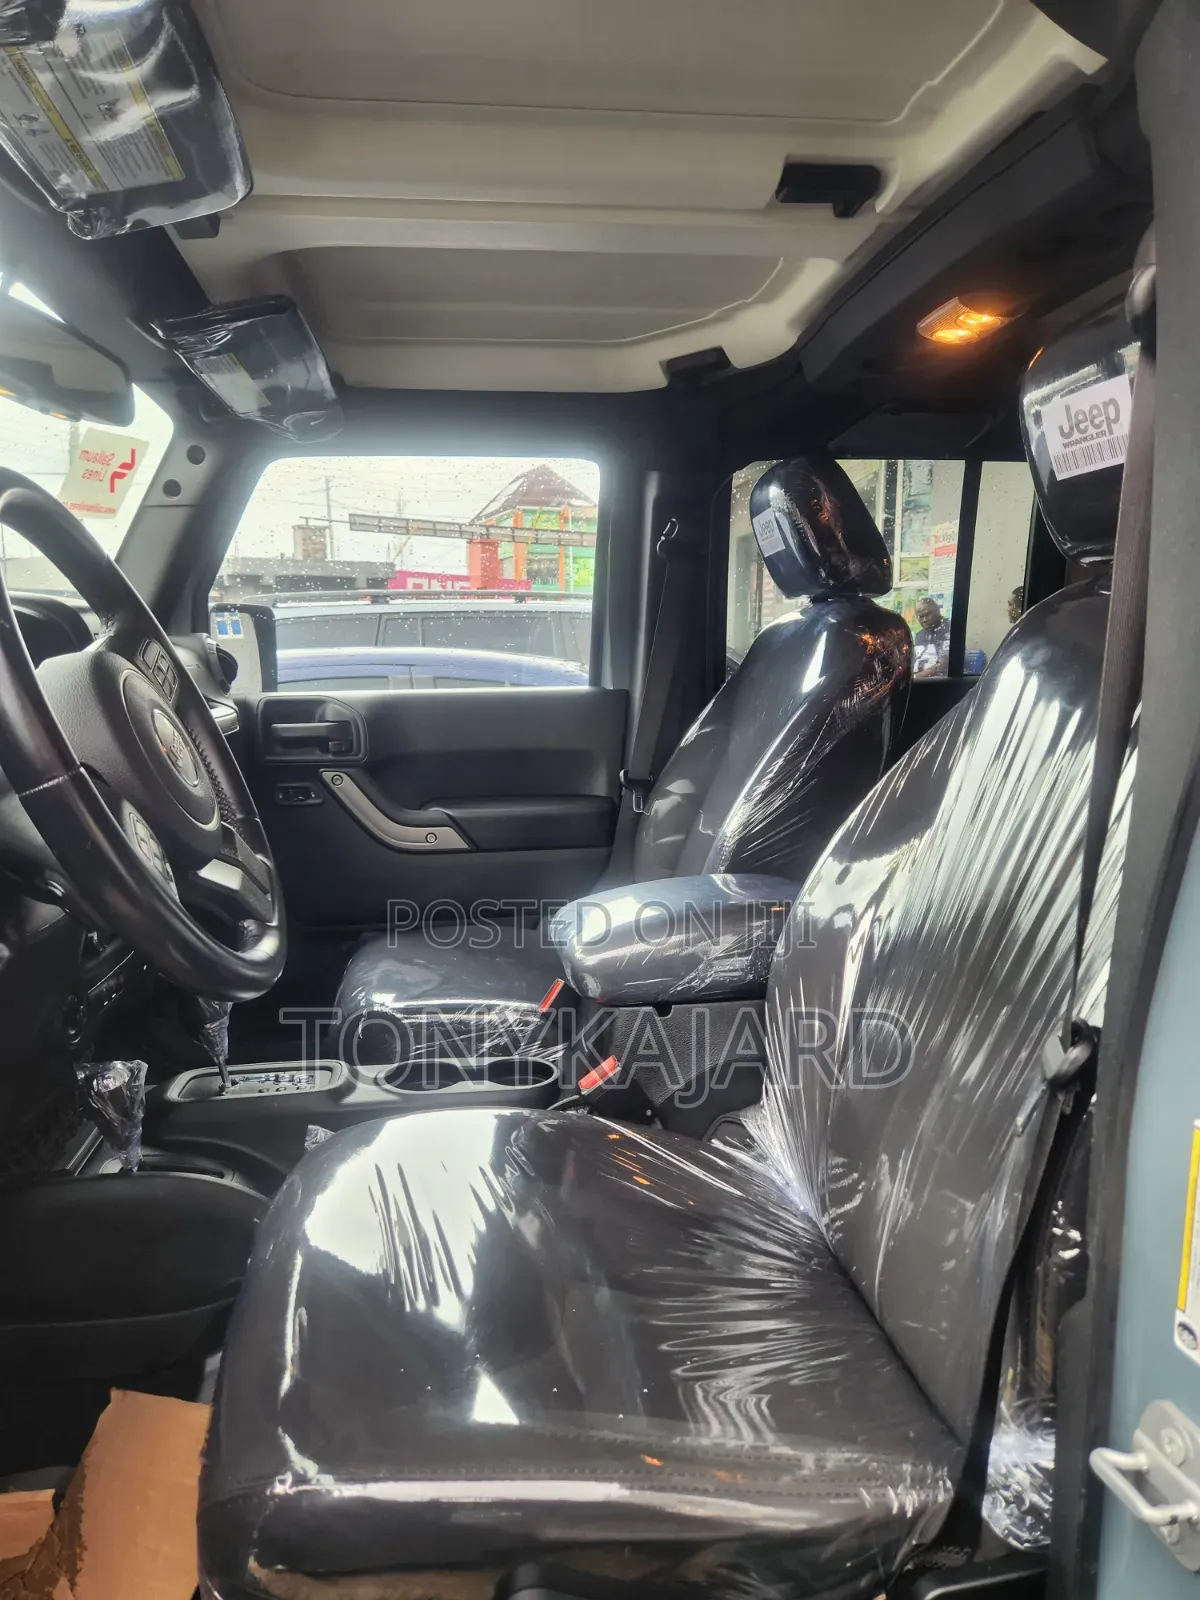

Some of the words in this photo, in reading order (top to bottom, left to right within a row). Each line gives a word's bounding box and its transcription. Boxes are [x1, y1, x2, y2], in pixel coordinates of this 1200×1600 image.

[1059, 398, 1120, 439] Jeep
[1062, 431, 1108, 449] WRANGLER
[758, 518, 775, 537] Jeep
